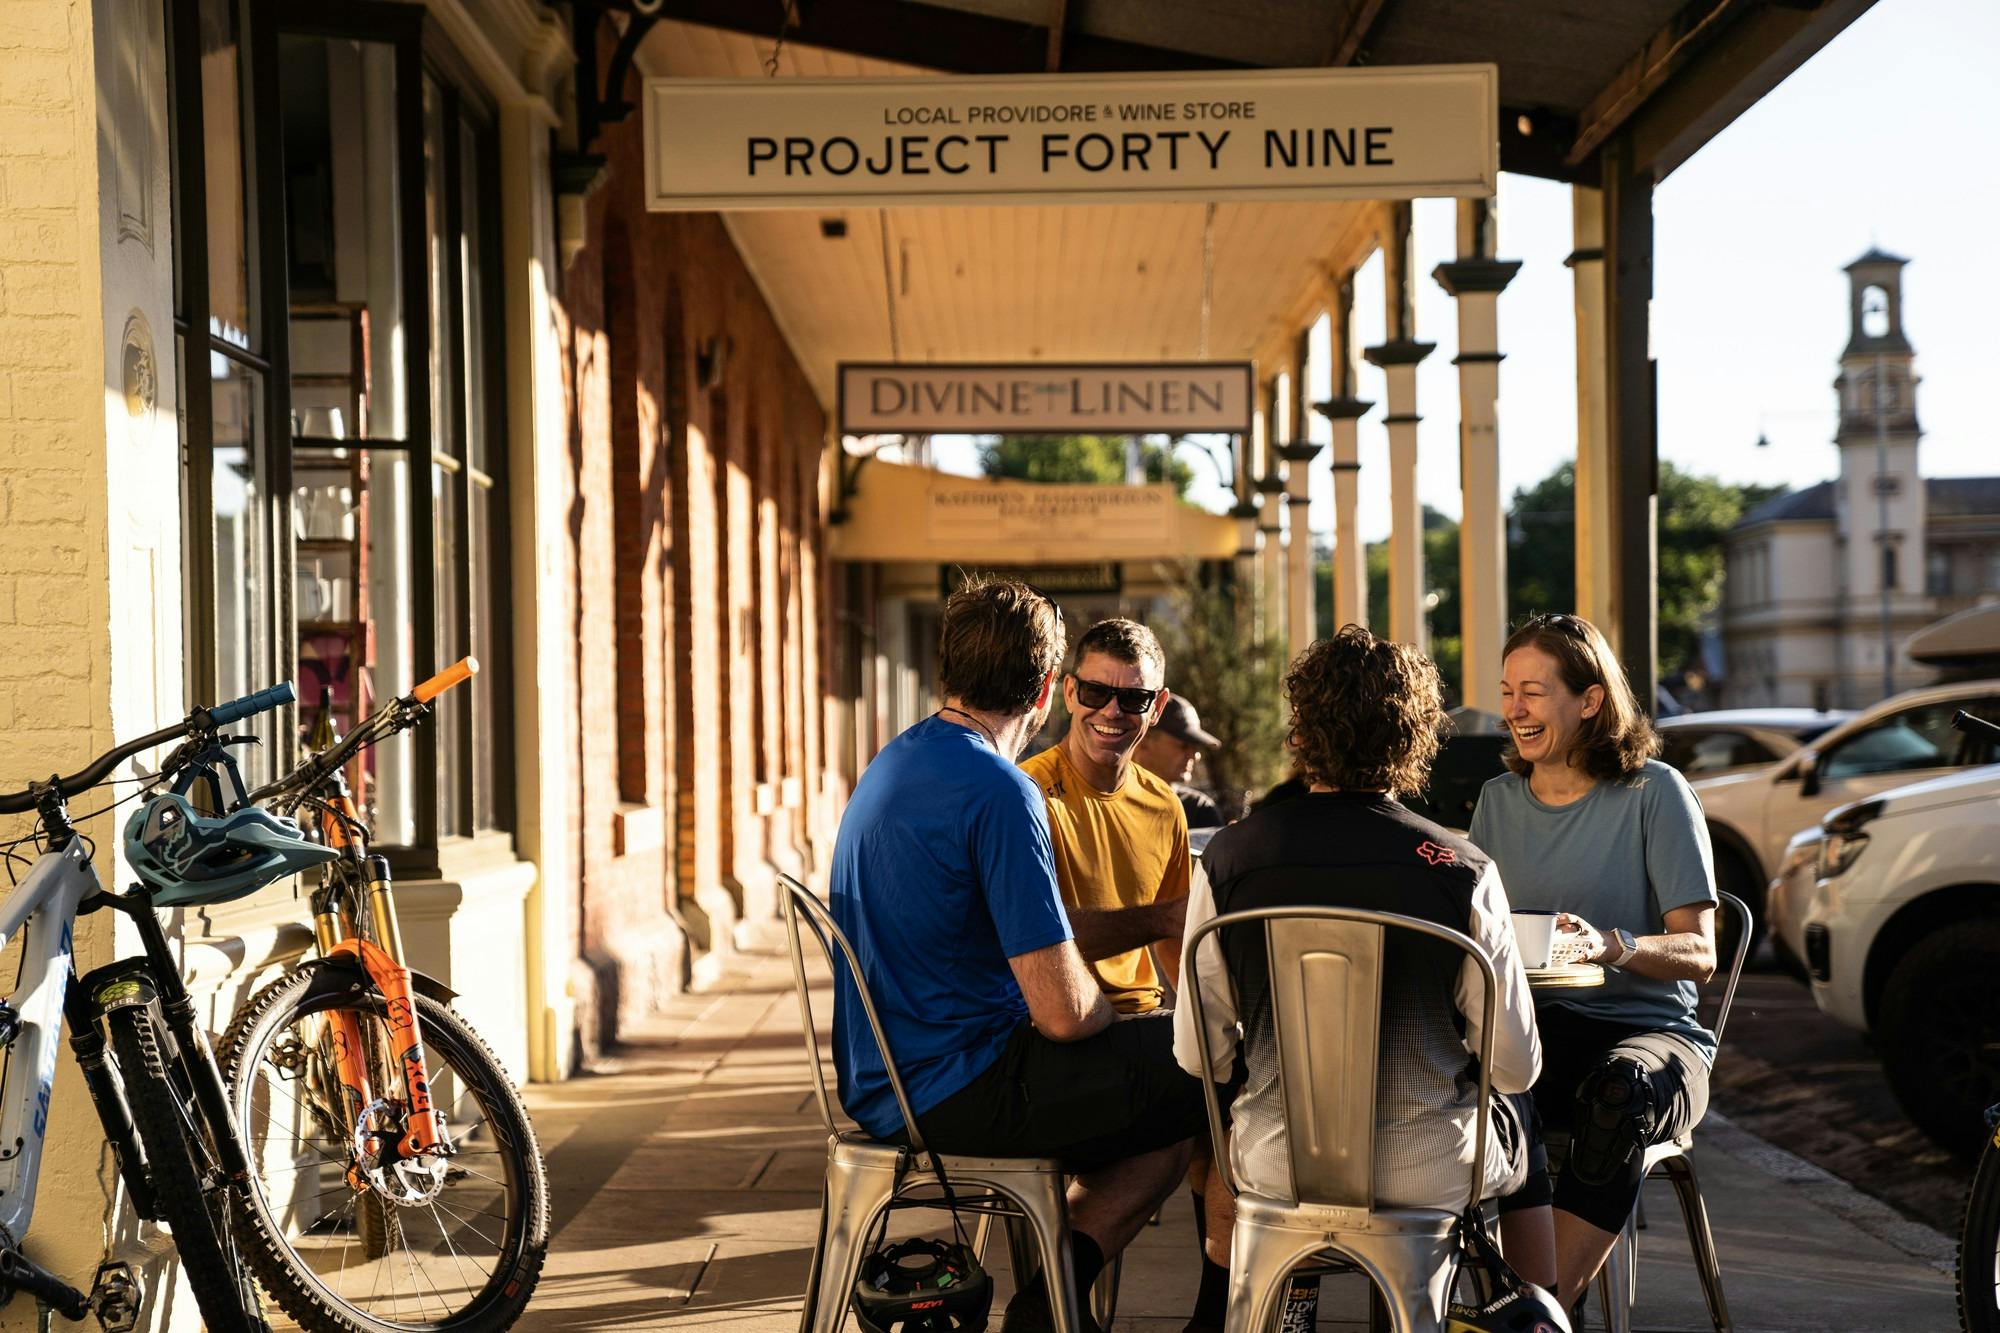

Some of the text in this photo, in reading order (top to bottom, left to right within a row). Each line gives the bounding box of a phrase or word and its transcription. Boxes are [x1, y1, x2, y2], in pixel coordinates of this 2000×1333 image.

[884, 106, 961, 125] LOCAL
[968, 104, 1096, 124] PROVIDORE
[1118, 103, 1176, 122] WINE
[1182, 102, 1256, 120] STORE
[747, 126, 1395, 177] PROJECT FORTY NINE
[870, 376, 1225, 417] DIVINE LINEN
[911, 1299, 945, 1310] LAZER
[1449, 1304, 1478, 1319] SMIT
